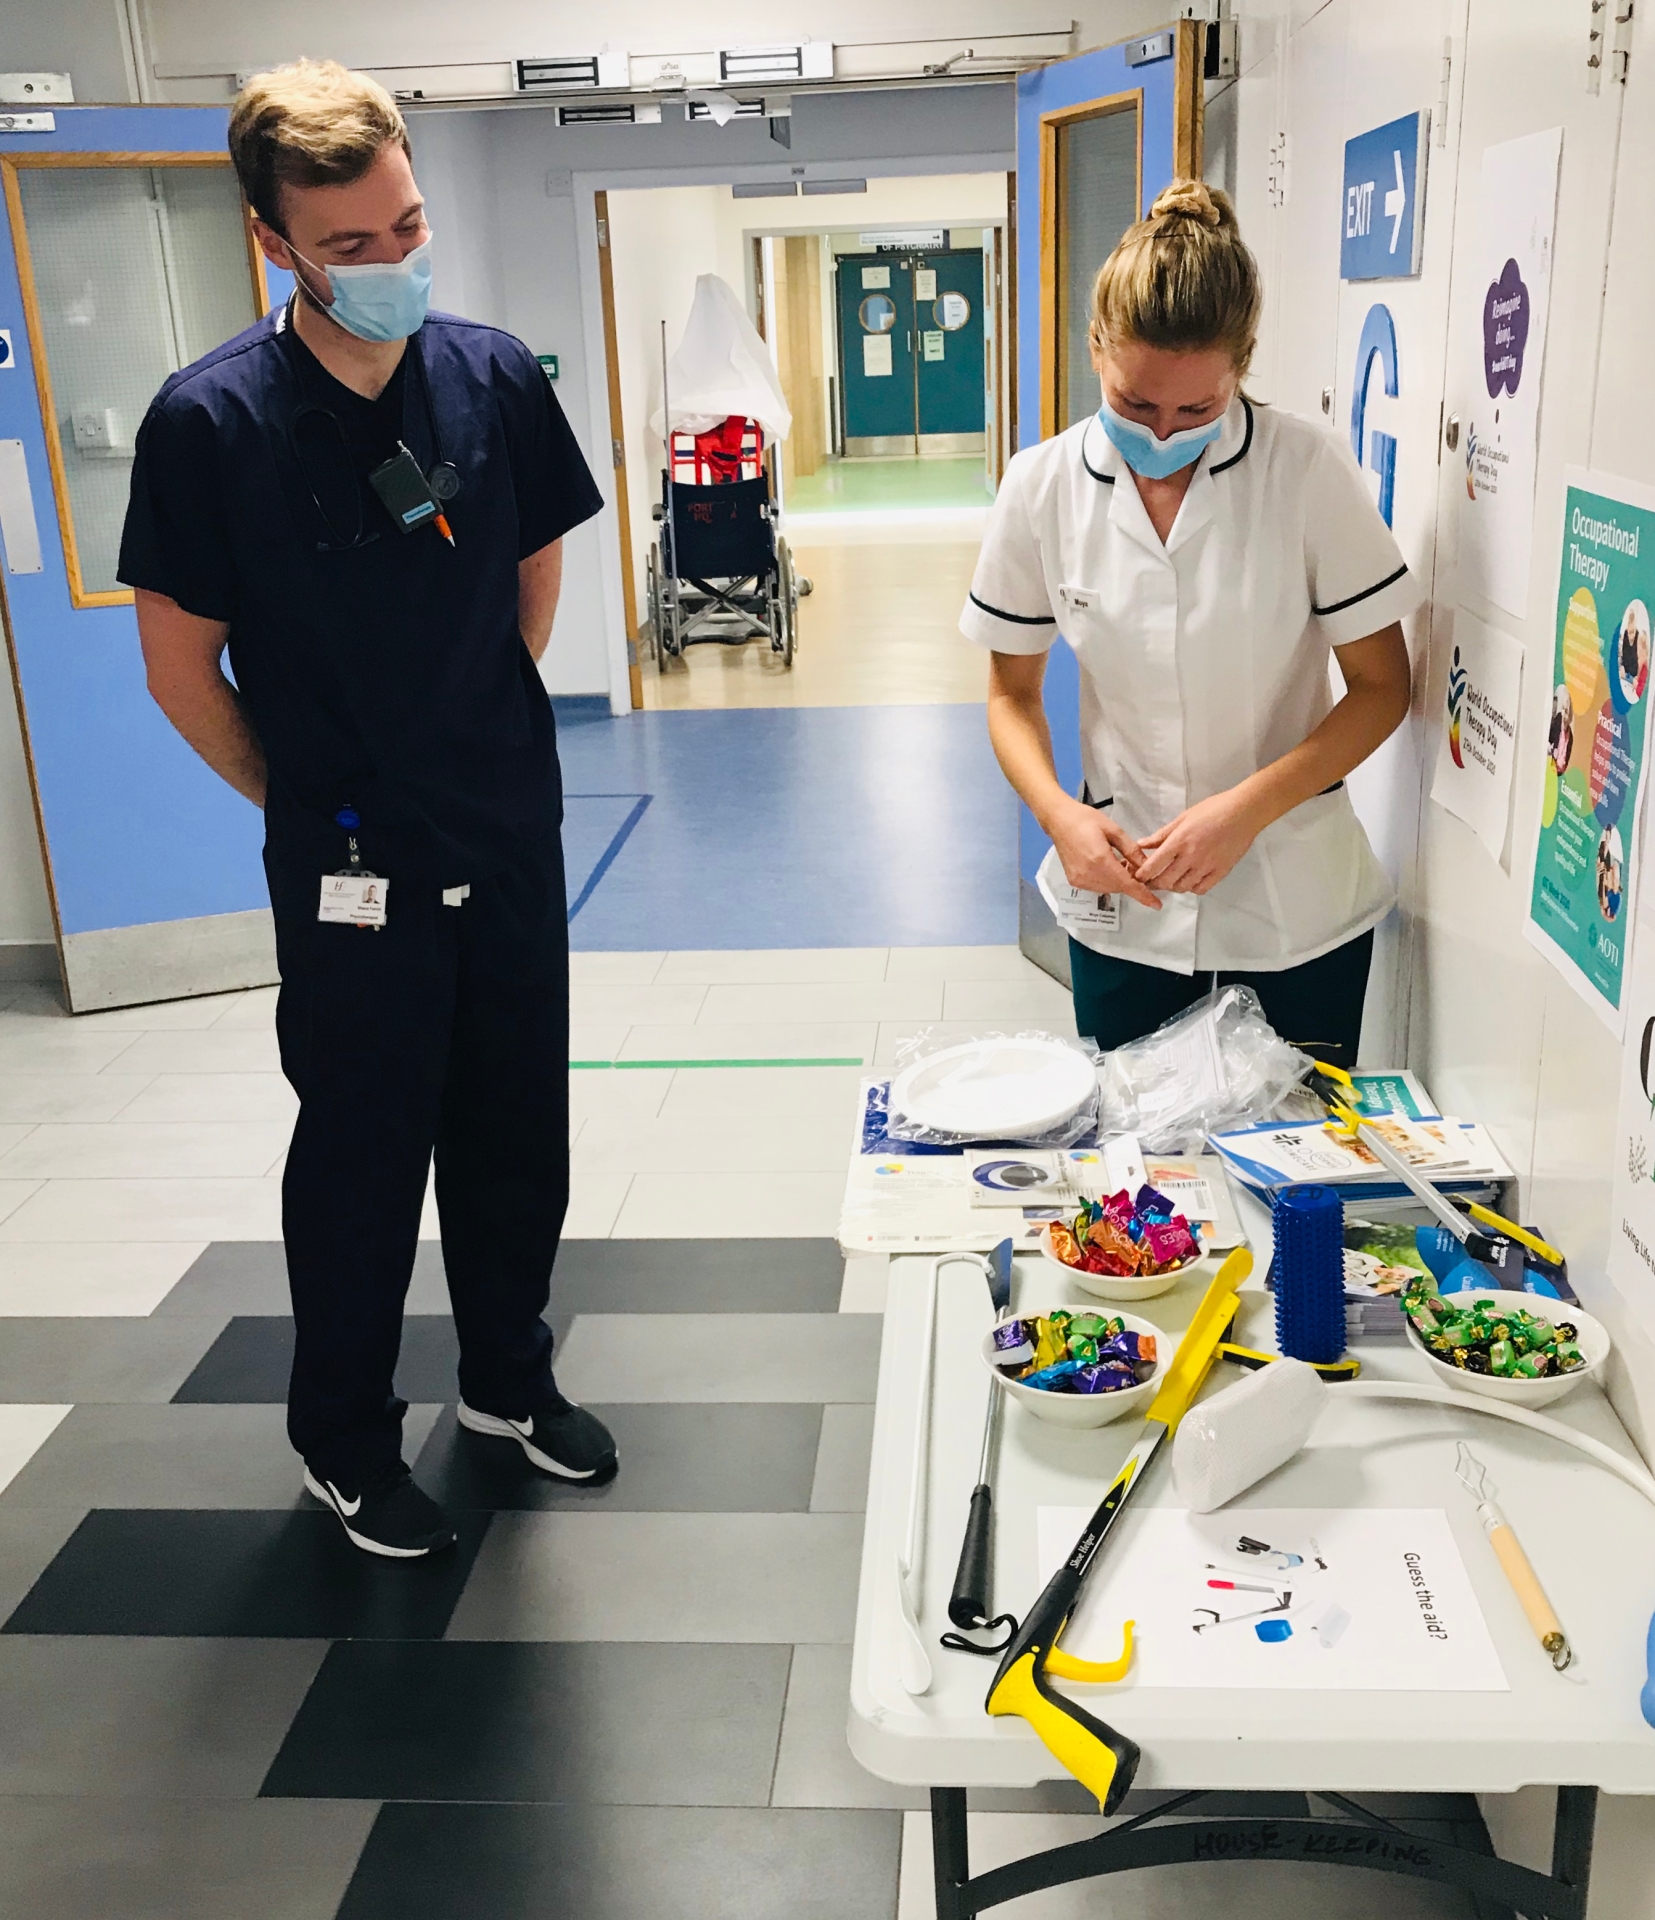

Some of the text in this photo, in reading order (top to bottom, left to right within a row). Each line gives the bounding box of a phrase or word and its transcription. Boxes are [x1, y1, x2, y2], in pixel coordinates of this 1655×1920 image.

[1346, 180, 1375, 240] EXIT
[894, 242, 944, 251] PSYCHIATRY
[1492, 292, 1521, 320] Reimagine
[1350, 303, 1399, 532] G
[1571, 506, 1640, 559] Occupational
[1569, 542, 1610, 593] Therapy
[1466, 706, 1498, 756] Therapy Day
[1467, 682, 1516, 740] World Occupational
[1597, 709, 1622, 740] Practical
[1560, 779, 1583, 810] Essential
[1597, 932, 1619, 967] AOTI
[1363, 1081, 1385, 1110] Therapy
[1382, 1081, 1411, 1115] Occupatio
[1622, 1217, 1640, 1254] Living
[1640, 1241, 1651, 1267] Life
[1069, 1533, 1096, 1569] Shoe Helper
[1403, 1552, 1448, 1640] Guess the aid?
